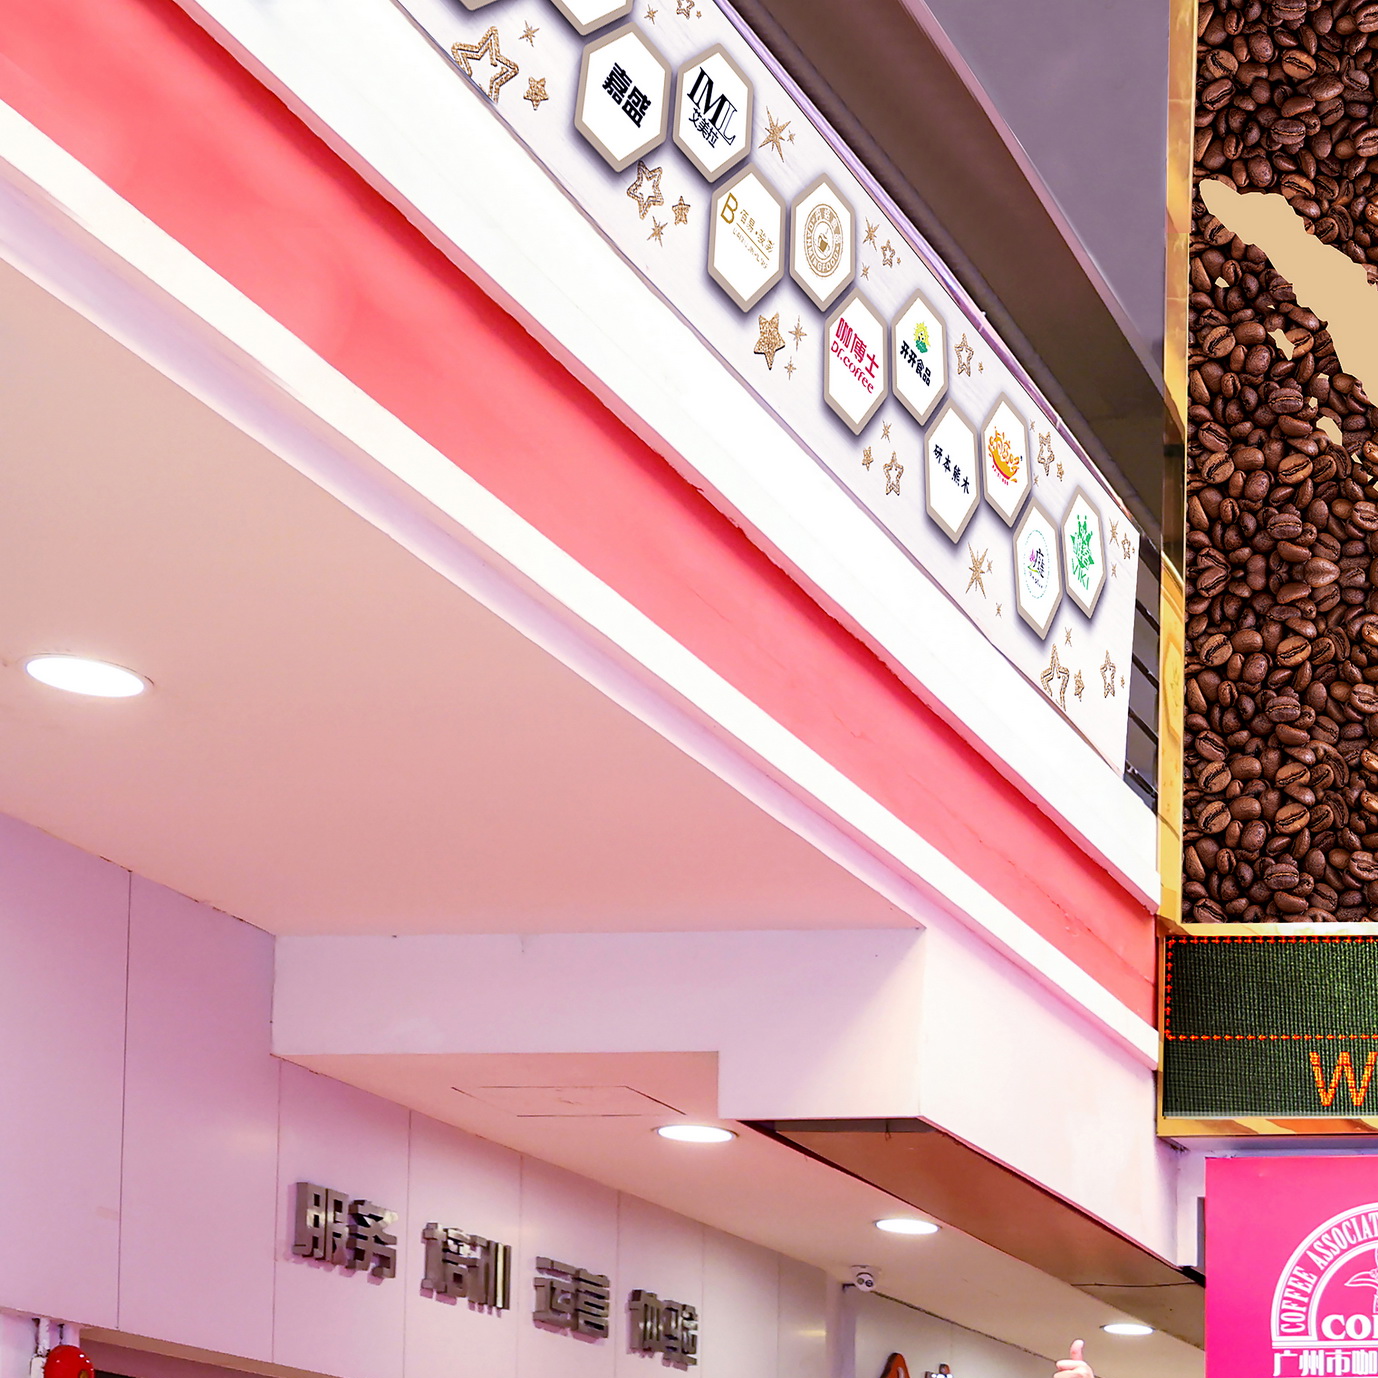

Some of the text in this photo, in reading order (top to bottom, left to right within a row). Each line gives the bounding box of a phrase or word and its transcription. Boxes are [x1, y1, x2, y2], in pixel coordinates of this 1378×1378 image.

[602, 62, 651, 128] 嘉盛
[831, 340, 875, 394] Dr.coffee
[835, 317, 879, 379] 咖博士
[900, 340, 931, 387] 开开食品
[292, 1182, 399, 1279] 服务
[422, 1222, 512, 1310] 培训
[1280, 1264, 1318, 1333] COFFEE
